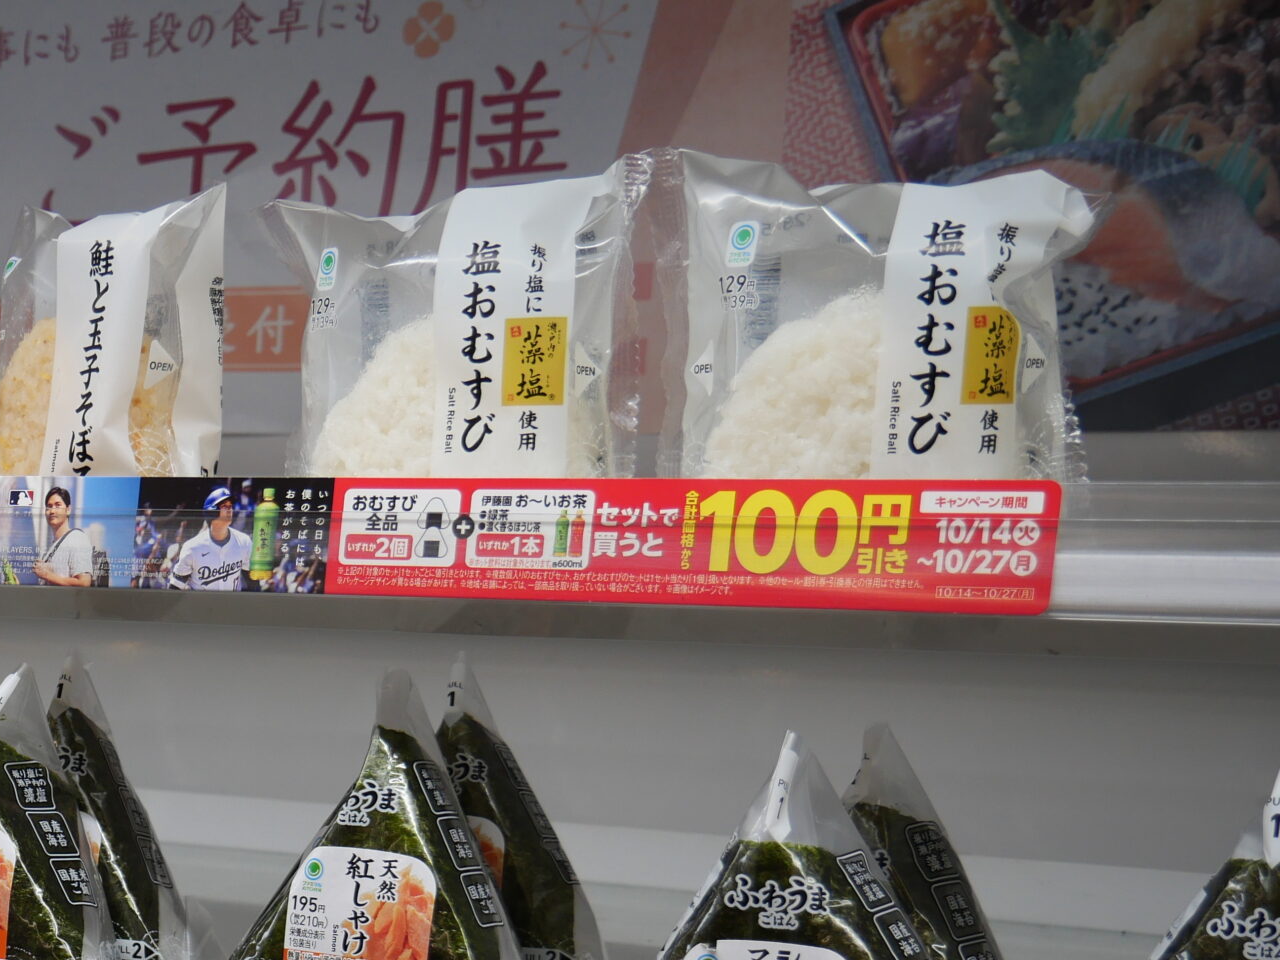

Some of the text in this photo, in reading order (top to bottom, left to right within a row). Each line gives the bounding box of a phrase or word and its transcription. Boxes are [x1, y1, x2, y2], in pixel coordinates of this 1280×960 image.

[101, 1, 381, 62] 普段の食卓にも
[525, 243, 548, 314] 振り塩に
[461, 240, 502, 453] 塩おむすび
[907, 219, 966, 455] 塩おむすび
[148, 361, 174, 372] OPEN
[575, 364, 596, 377] OPEN
[1024, 357, 1045, 370] OPEN
[445, 387, 456, 454] Salt Rice Ball
[518, 410, 539, 452] 使用
[886, 381, 902, 456] Salt Rice Ball
[978, 409, 1000, 455] 使用
[351, 494, 419, 513] おむすび
[481, 494, 512, 507] 伊藤園
[934, 494, 1028, 510] キャンペーン期間
[364, 513, 398, 531] 全品
[596, 501, 679, 528] セットで
[347, 536, 409, 559] いずれか2個
[478, 535, 541, 557] いずれか1本
[592, 530, 664, 558] 買うと
[197, 558, 243, 582] Dodgers
[855, 546, 908, 575] 引き
[39, 819, 63, 834] 国産
[337, 811, 370, 826] ごはん
[45, 832, 68, 848] 海苔
[376, 858, 400, 902] 天然
[291, 894, 326, 914] 195円
[341, 853, 375, 957] 紅しゃけ
[725, 874, 831, 915] ふわうま
[758, 910, 798, 929] ごはん
[331, 924, 339, 953] Salmon
